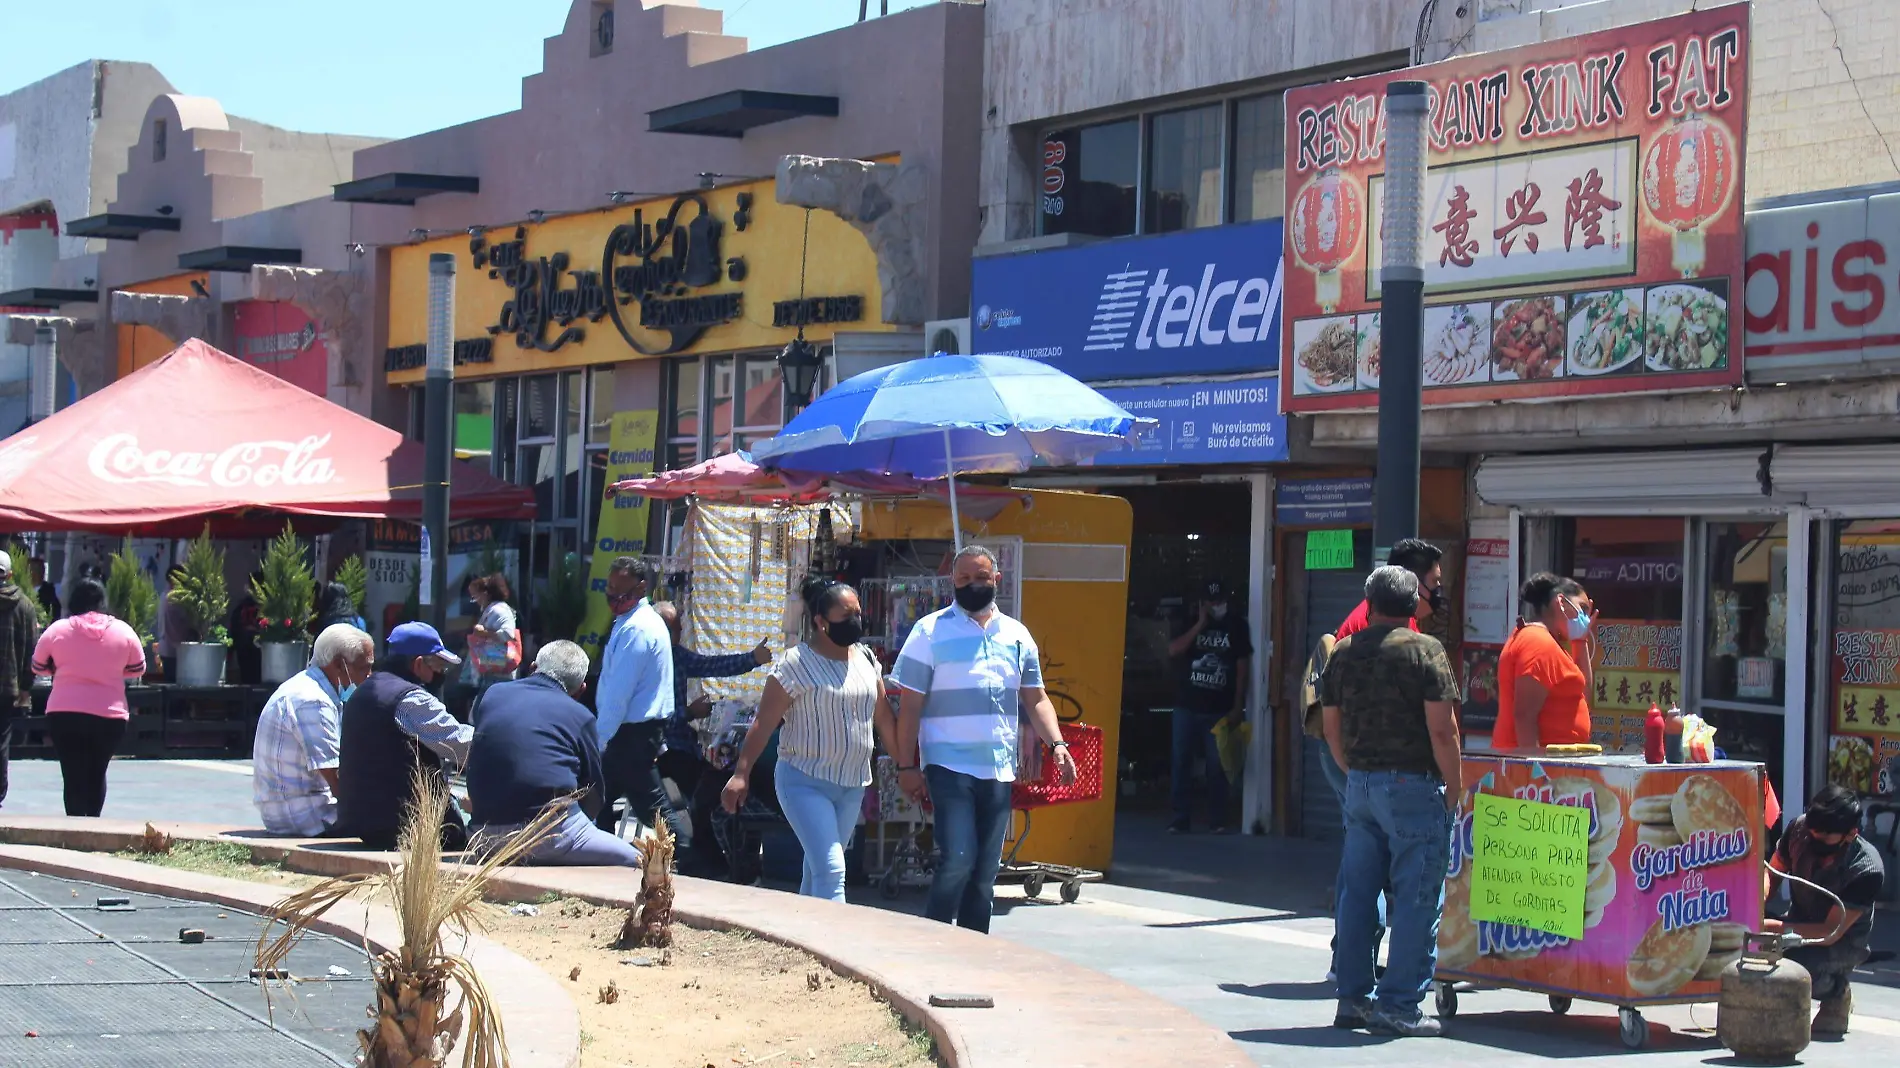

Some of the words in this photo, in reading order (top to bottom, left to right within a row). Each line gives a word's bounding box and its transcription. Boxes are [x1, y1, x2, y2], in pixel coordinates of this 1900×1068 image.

[1296, 69, 1509, 172] RESTARANT
[1518, 48, 1627, 136] XINK
[1648, 27, 1738, 117] FAT
[1380, 167, 1623, 268] 意兴隆
[1745, 220, 1900, 335] ais
[1134, 256, 1284, 351] telcel
[1021, 347, 1063, 359] AUTORIZADO
[1113, 399, 1133, 410] évate
[1134, 401, 1143, 409] un
[1143, 398, 1167, 409] celular
[1168, 398, 1189, 408] nuevo
[1191, 391, 1209, 409] ¡EN
[1213, 387, 1268, 406] MINUTOS!
[1212, 422, 1223, 434] No
[1224, 421, 1271, 433] revisamos
[1207, 435, 1228, 449] Buró
[1229, 435, 1240, 447] de
[1241, 434, 1275, 447] Crédito
[87, 430, 336, 488] Coca-Cola
[369, 557, 407, 571] DESDE
[1196, 633, 1231, 648] PAPÁ
[1836, 630, 1900, 658] RESTA
[1601, 645, 1641, 667] XINK
[1647, 645, 1683, 669] FAT
[1841, 657, 1900, 684] XINK
[1842, 693, 1900, 727] 生意
[1879, 736, 1900, 750] Arro
[1548, 844, 1584, 866] PARA
[1630, 827, 1747, 890] Gorditas
[1482, 865, 1523, 884] ATENDER
[1530, 866, 1575, 888] PUESTO
[1682, 869, 1703, 894] de
[1486, 889, 1501, 905] DE
[1513, 894, 1567, 914] GORDITAS
[1657, 887, 1728, 932] Nata
